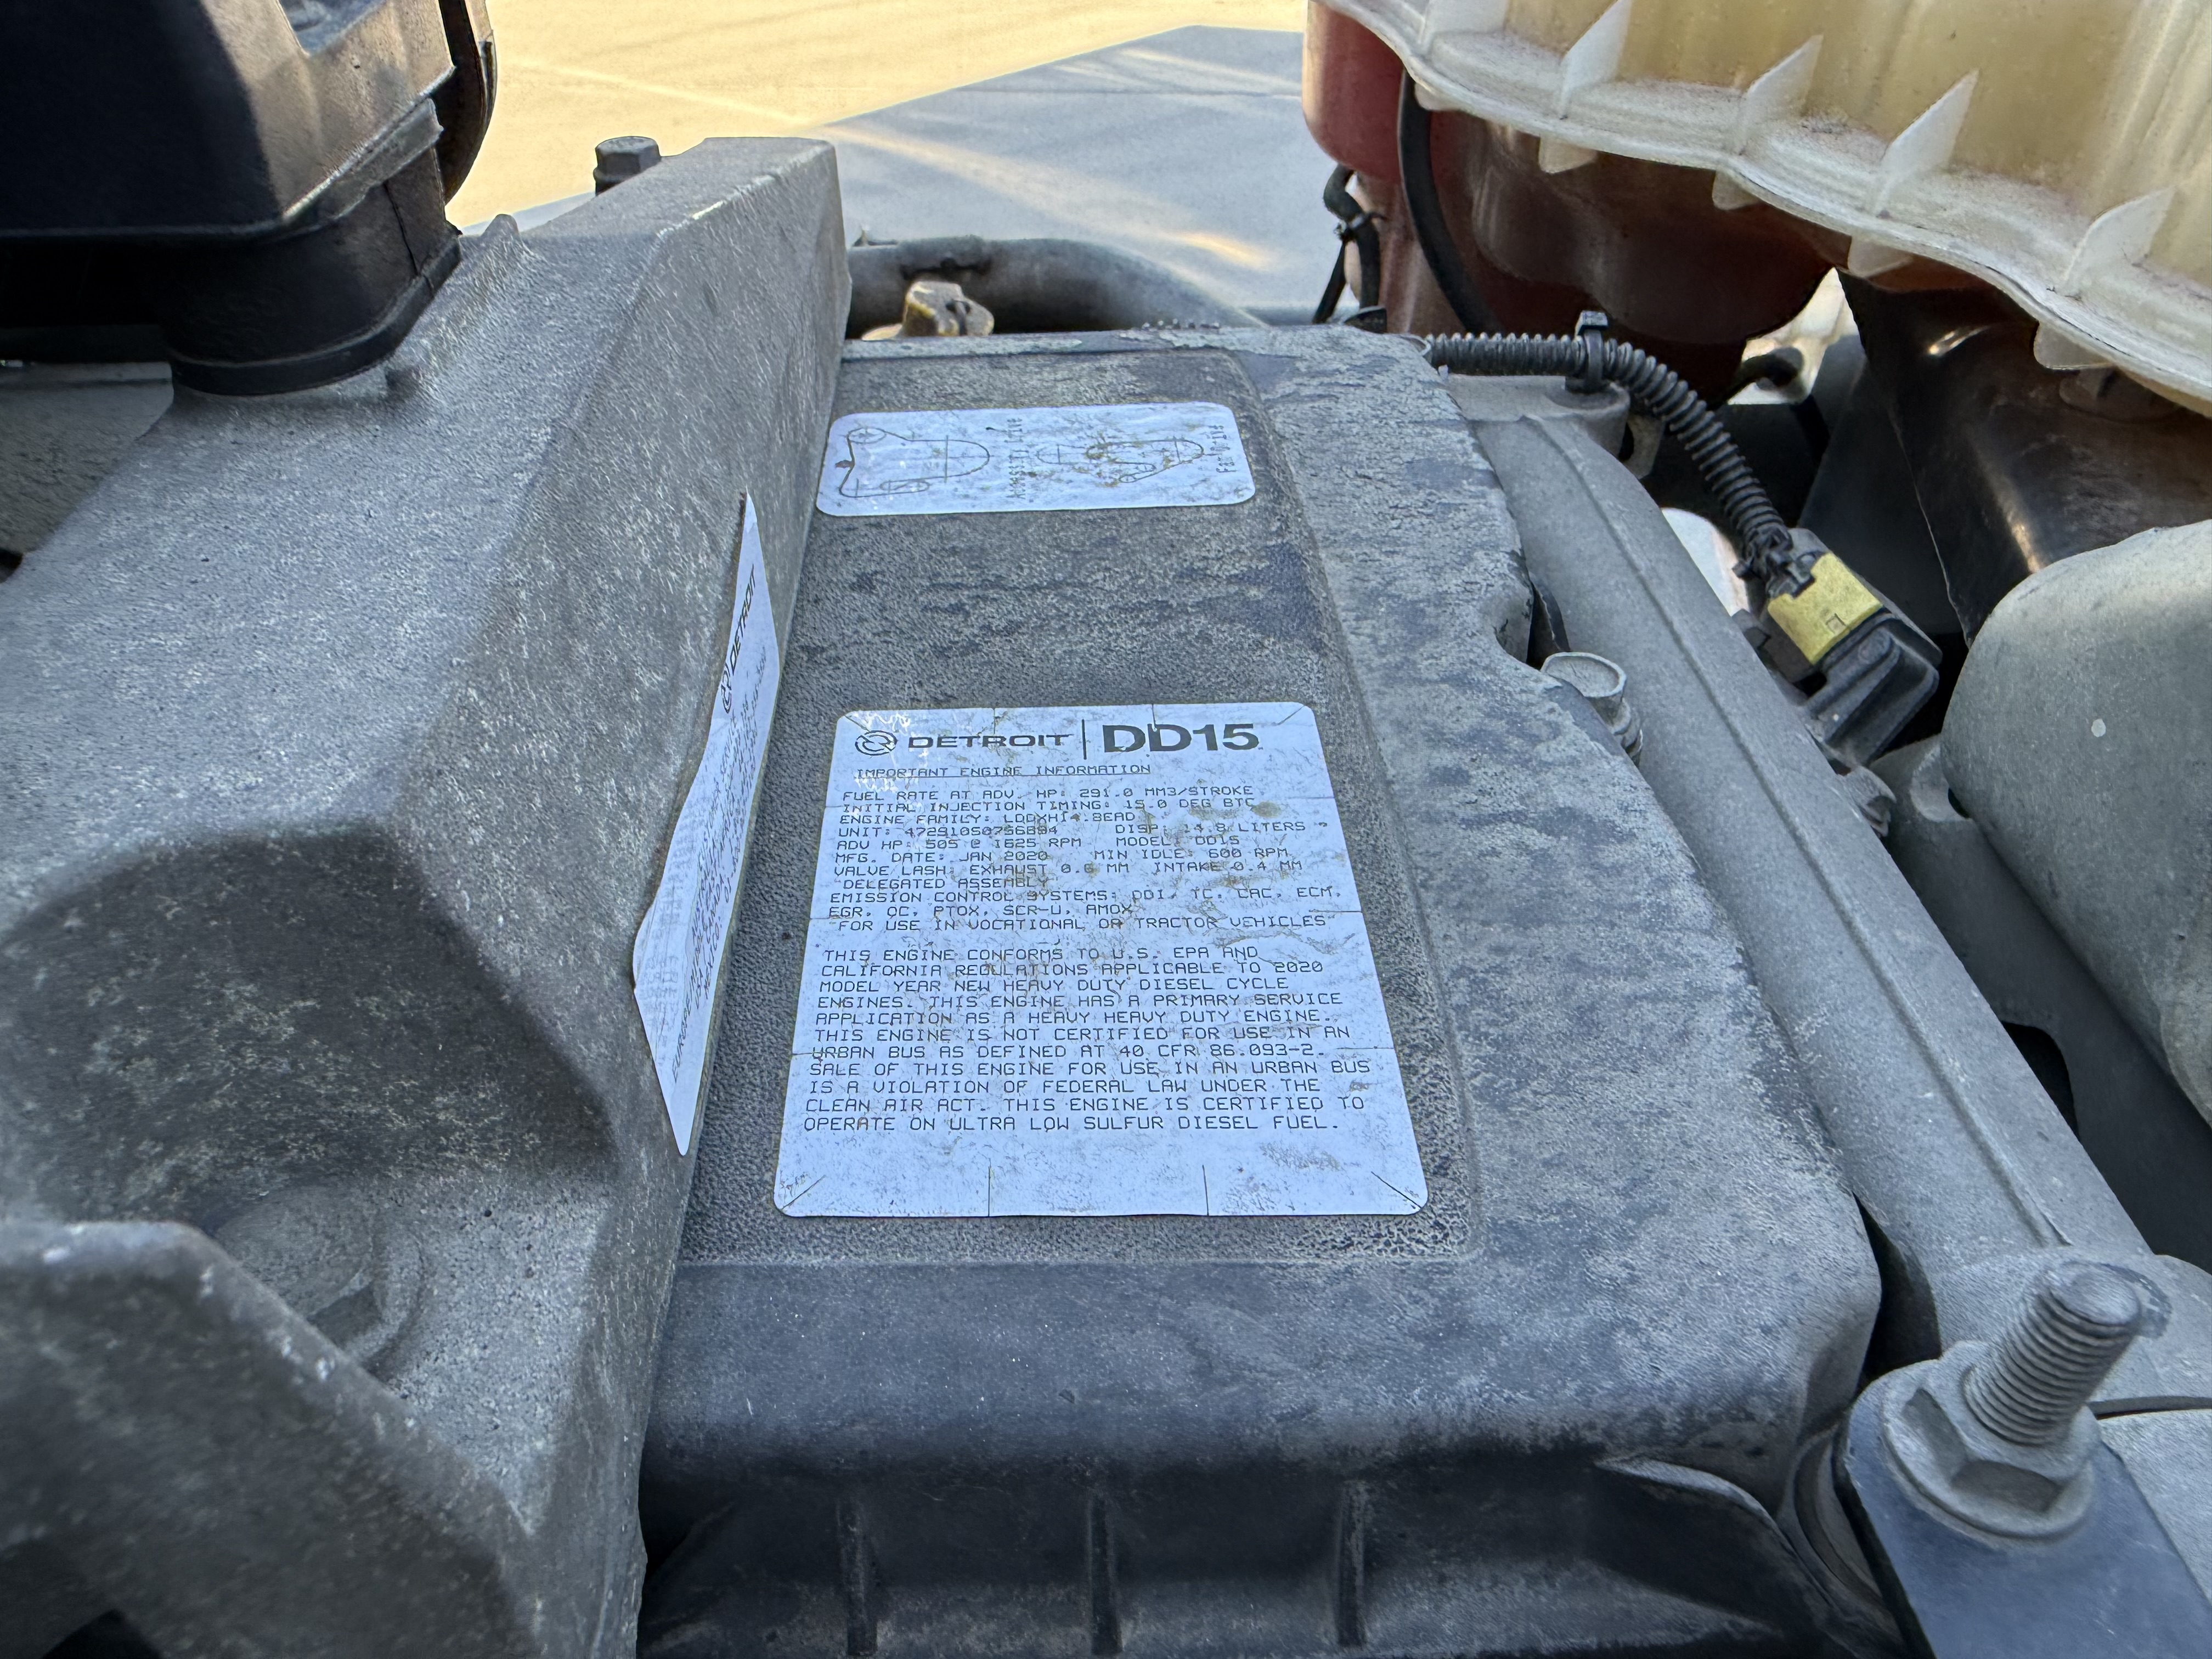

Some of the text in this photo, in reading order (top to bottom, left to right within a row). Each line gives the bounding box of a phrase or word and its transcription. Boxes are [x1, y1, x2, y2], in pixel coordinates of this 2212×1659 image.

[730, 563, 755, 676] DETROIT
[908, 723, 1260, 753] DETROIT DD15
[857, 764, 1151, 777] IMPORTANT ENGINE INFORMATION
[843, 791, 885, 801] FUEL
[895, 790, 939, 800] RATE
[950, 789, 974, 799] AT
[1079, 787, 1133, 798] 291.0
[1144, 786, 1254, 797] MM3/STROKE
[843, 802, 917, 813] INITIAL
[930, 800, 1025, 812] INJECTION
[1179, 798, 1215, 808] DEG
[1223, 797, 1255, 808] BTC
[839, 815, 906, 824] ENGINE
[1238, 822, 1306, 832] LITERS
[838, 826, 890, 837] UNIT:
[836, 839, 870, 850] ADV
[925, 839, 958, 849] 505
[995, 838, 1037, 848] 1625
[1048, 837, 1081, 847] RPM
[834, 850, 1048, 863] MFG. DATE: JAN 2020
[1092, 848, 1288, 860] MIN 600 RPM
[834, 866, 890, 876] VALVE
[969, 864, 1048, 874] EXHAUST
[1107, 863, 1130, 873] MM
[1154, 862, 1226, 872] INTAKE
[1279, 861, 1302, 871] MM
[830, 891, 922, 903] EMISSION
[934, 890, 1013, 902] CONTROL
[885, 919, 921, 930] USE
[934, 919, 955, 930] IN
[968, 917, 1087, 930] VOCATIONAL
[1098, 917, 1126, 928] OR
[1133, 916, 1216, 928] TRACTOR
[824, 946, 1258, 962] THIS ENGINE CONFORMS TO U.S. EPA AND
[821, 961, 1323, 977] CALIFORNIA REGULATIONS APPLICABLE TO 2020
[819, 978, 1289, 992] MODEL YEAR NEW HEAVY DUTY DIESEL CYCLE
[817, 992, 1344, 1008] ENGINES. THIS ENGINE HAS A PRIMARY SERVICE
[815, 1009, 1331, 1025] APPLICATION AS A HEAVY HEAVY DUTY ENGINE.
[815, 1026, 1350, 1042] THIS ENGINE IS NOT CERTIFIED FOR USE IN AN
[811, 1046, 874, 1059] URBAN
[888, 1046, 926, 1058] BUS
[939, 1046, 964, 1058] AS
[975, 1045, 1066, 1058] DEFINED
[1080, 1045, 1105, 1057] AT
[1118, 1045, 1144, 1057] 40
[1158, 1044, 1197, 1057] CFR
[809, 1060, 1370, 1076] SALE OF THIS ENGINE FOR USE IN AN URBAN BUS
[810, 1078, 1321, 1093] IS A VIOLATION OF FEDERAL LAW UNDER THE
[805, 1097, 1365, 1112] CLEAN AIR ACT. THIS ENGINE IS CERTIFIED TO
[804, 1116, 1338, 1131] OPERATE ON ULTRA LOW SULFUR DIESEL FUEL.
